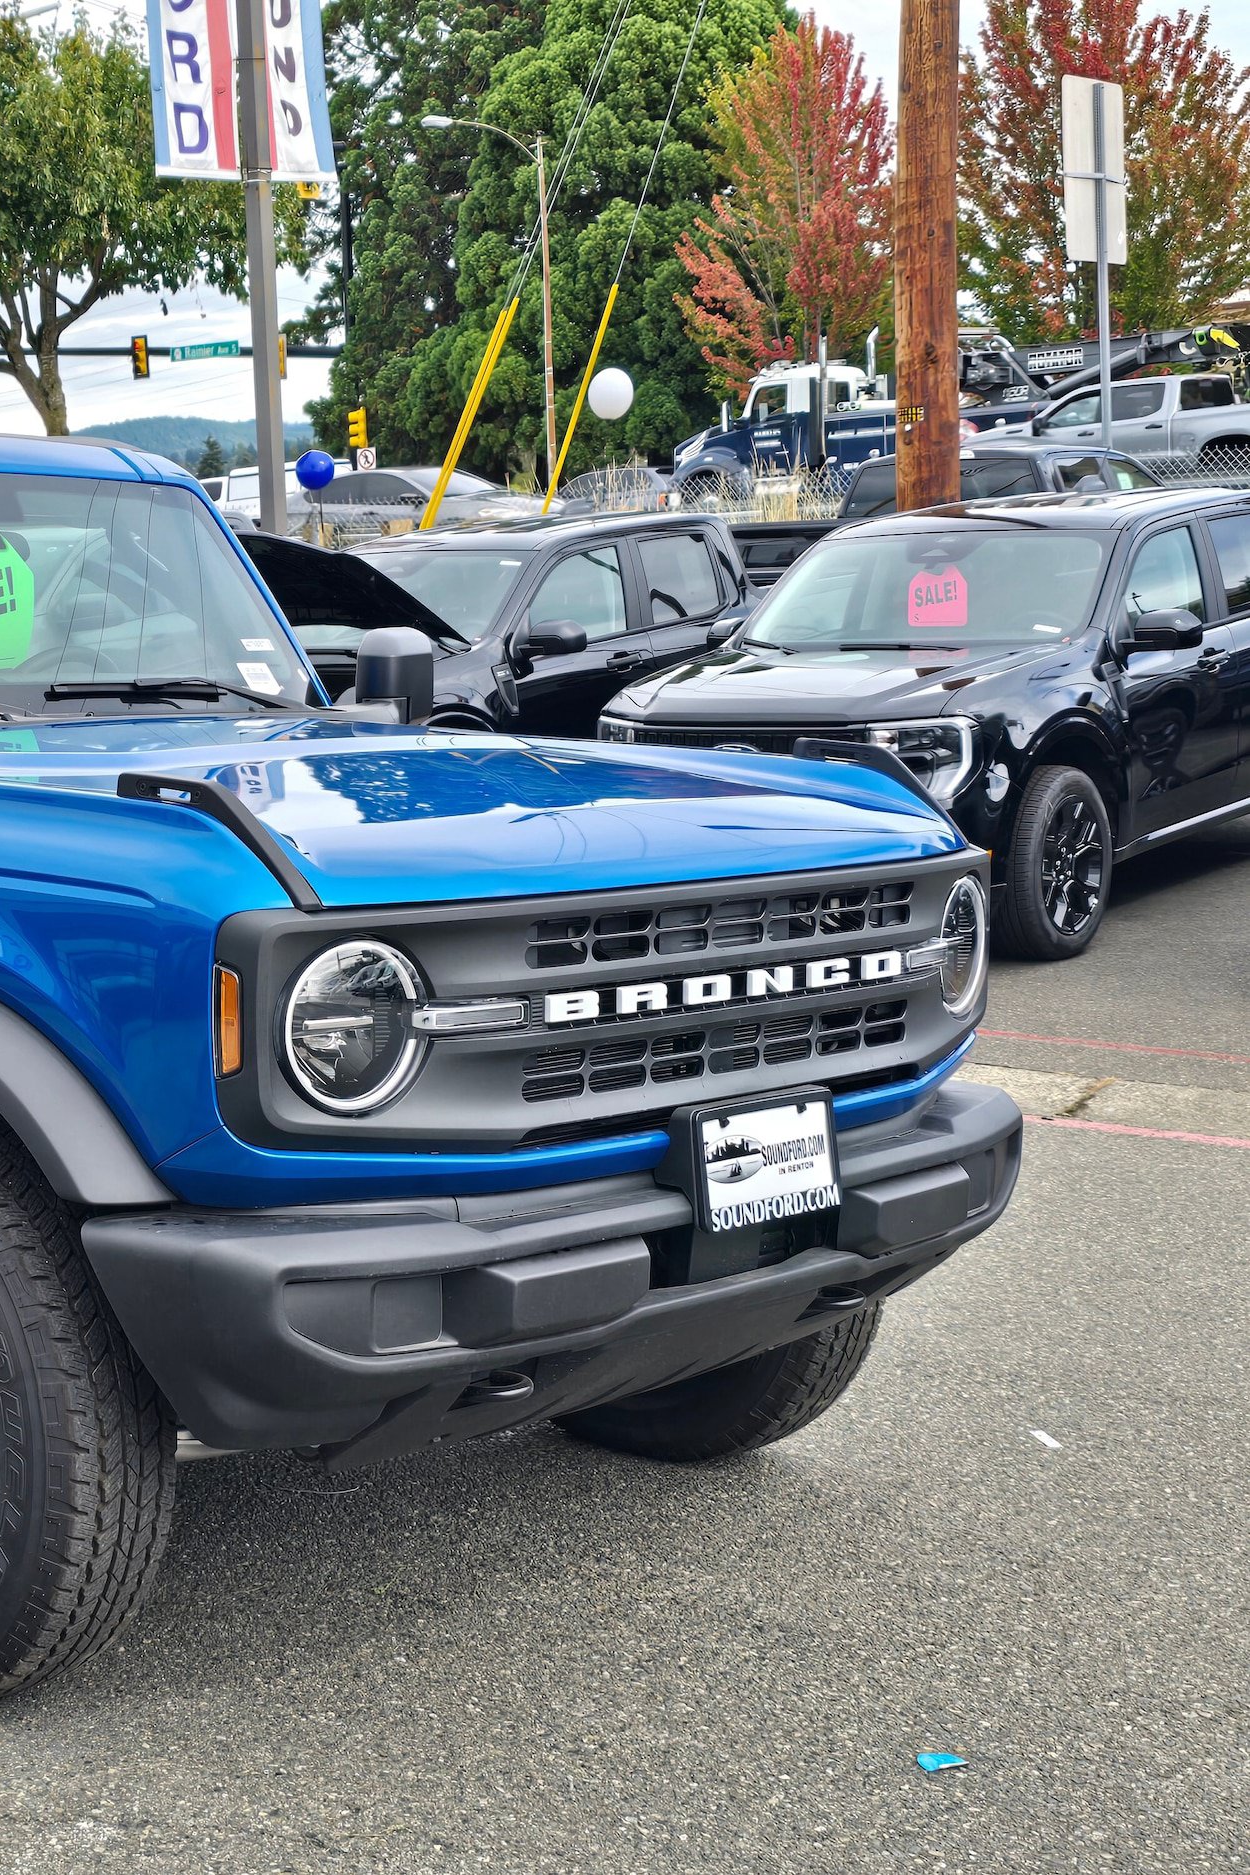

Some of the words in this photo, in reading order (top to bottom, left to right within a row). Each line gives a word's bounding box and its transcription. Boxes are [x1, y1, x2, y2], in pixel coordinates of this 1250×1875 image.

[166, 0, 209, 155] RD
[184, 346, 215, 360] Rainier
[914, 580, 958, 608] SALE!
[544, 950, 902, 1024] BRONCO
[761, 1133, 826, 1167] SOUNDFORD.COM
[778, 1167, 786, 1175] IN
[787, 1161, 815, 1174] RENTON
[711, 1183, 841, 1233] SOUNDFORD.COM
